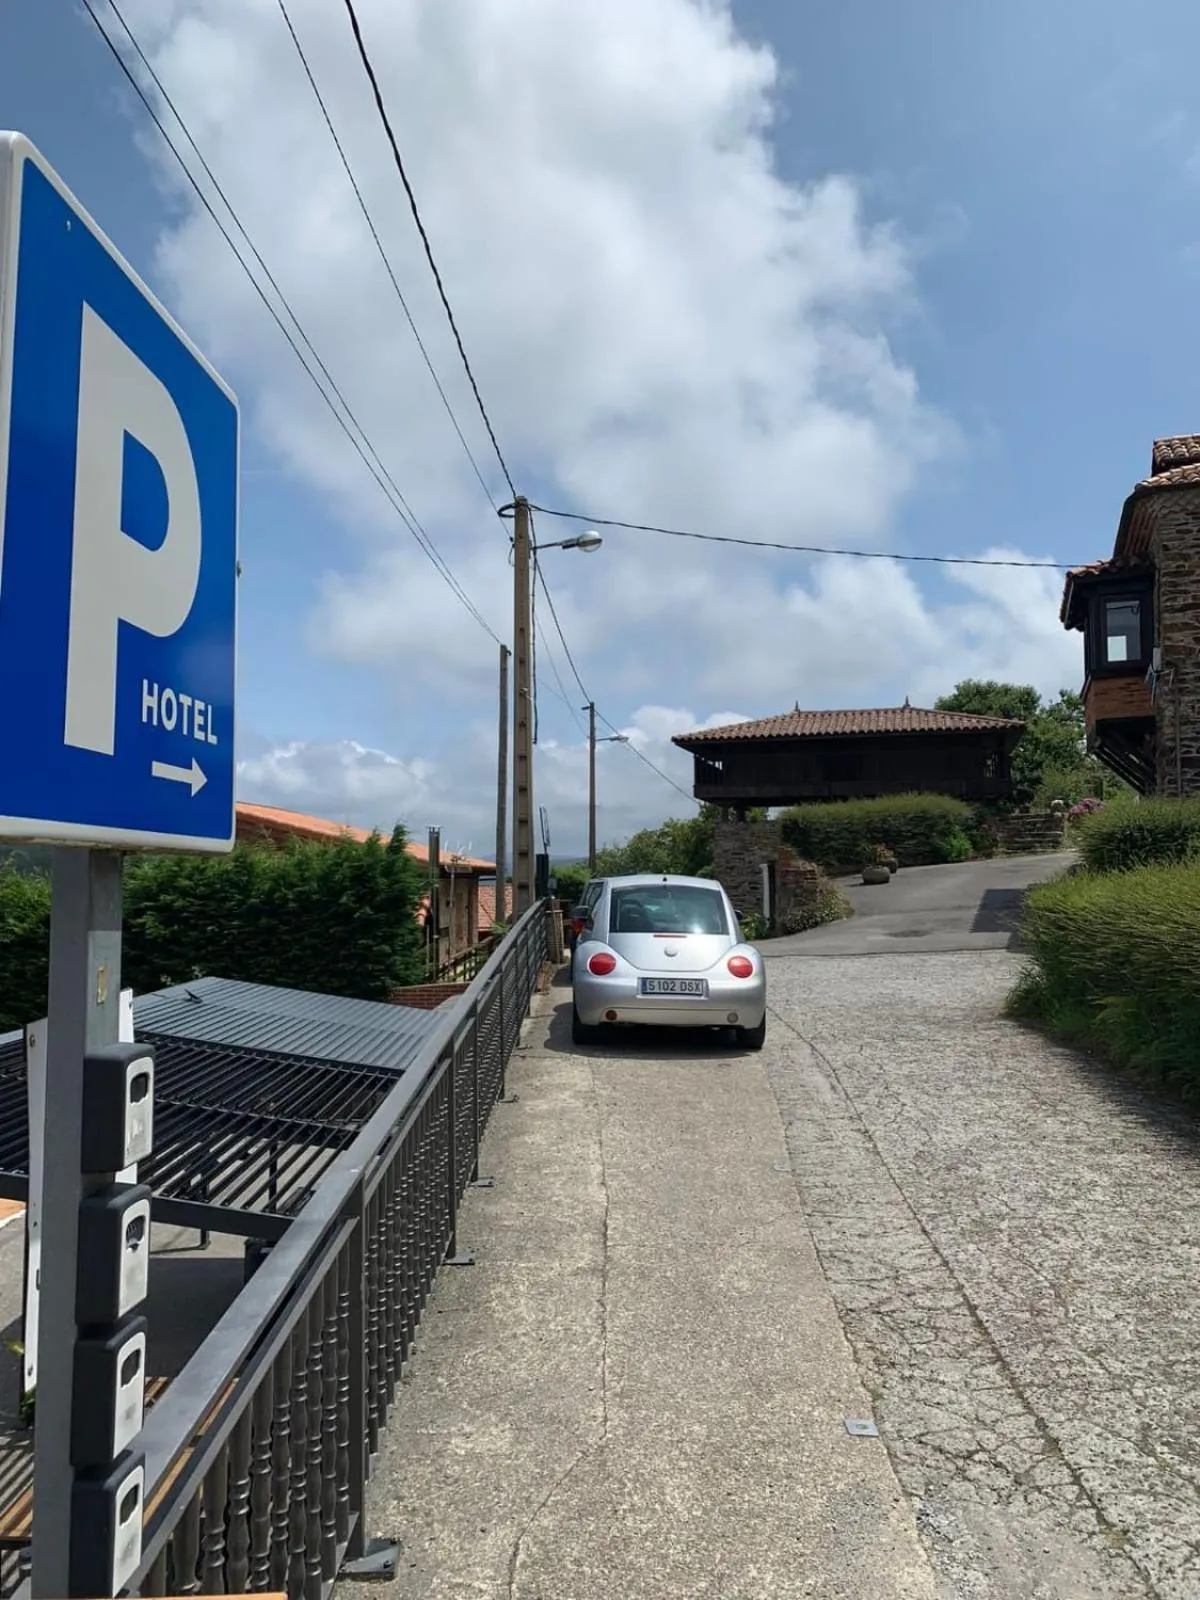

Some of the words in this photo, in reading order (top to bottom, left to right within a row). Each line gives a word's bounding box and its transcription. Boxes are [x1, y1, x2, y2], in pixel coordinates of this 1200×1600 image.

[63, 301, 202, 756] P
[142, 678, 218, 745] HOTEL
[648, 980, 676, 991] 5102
